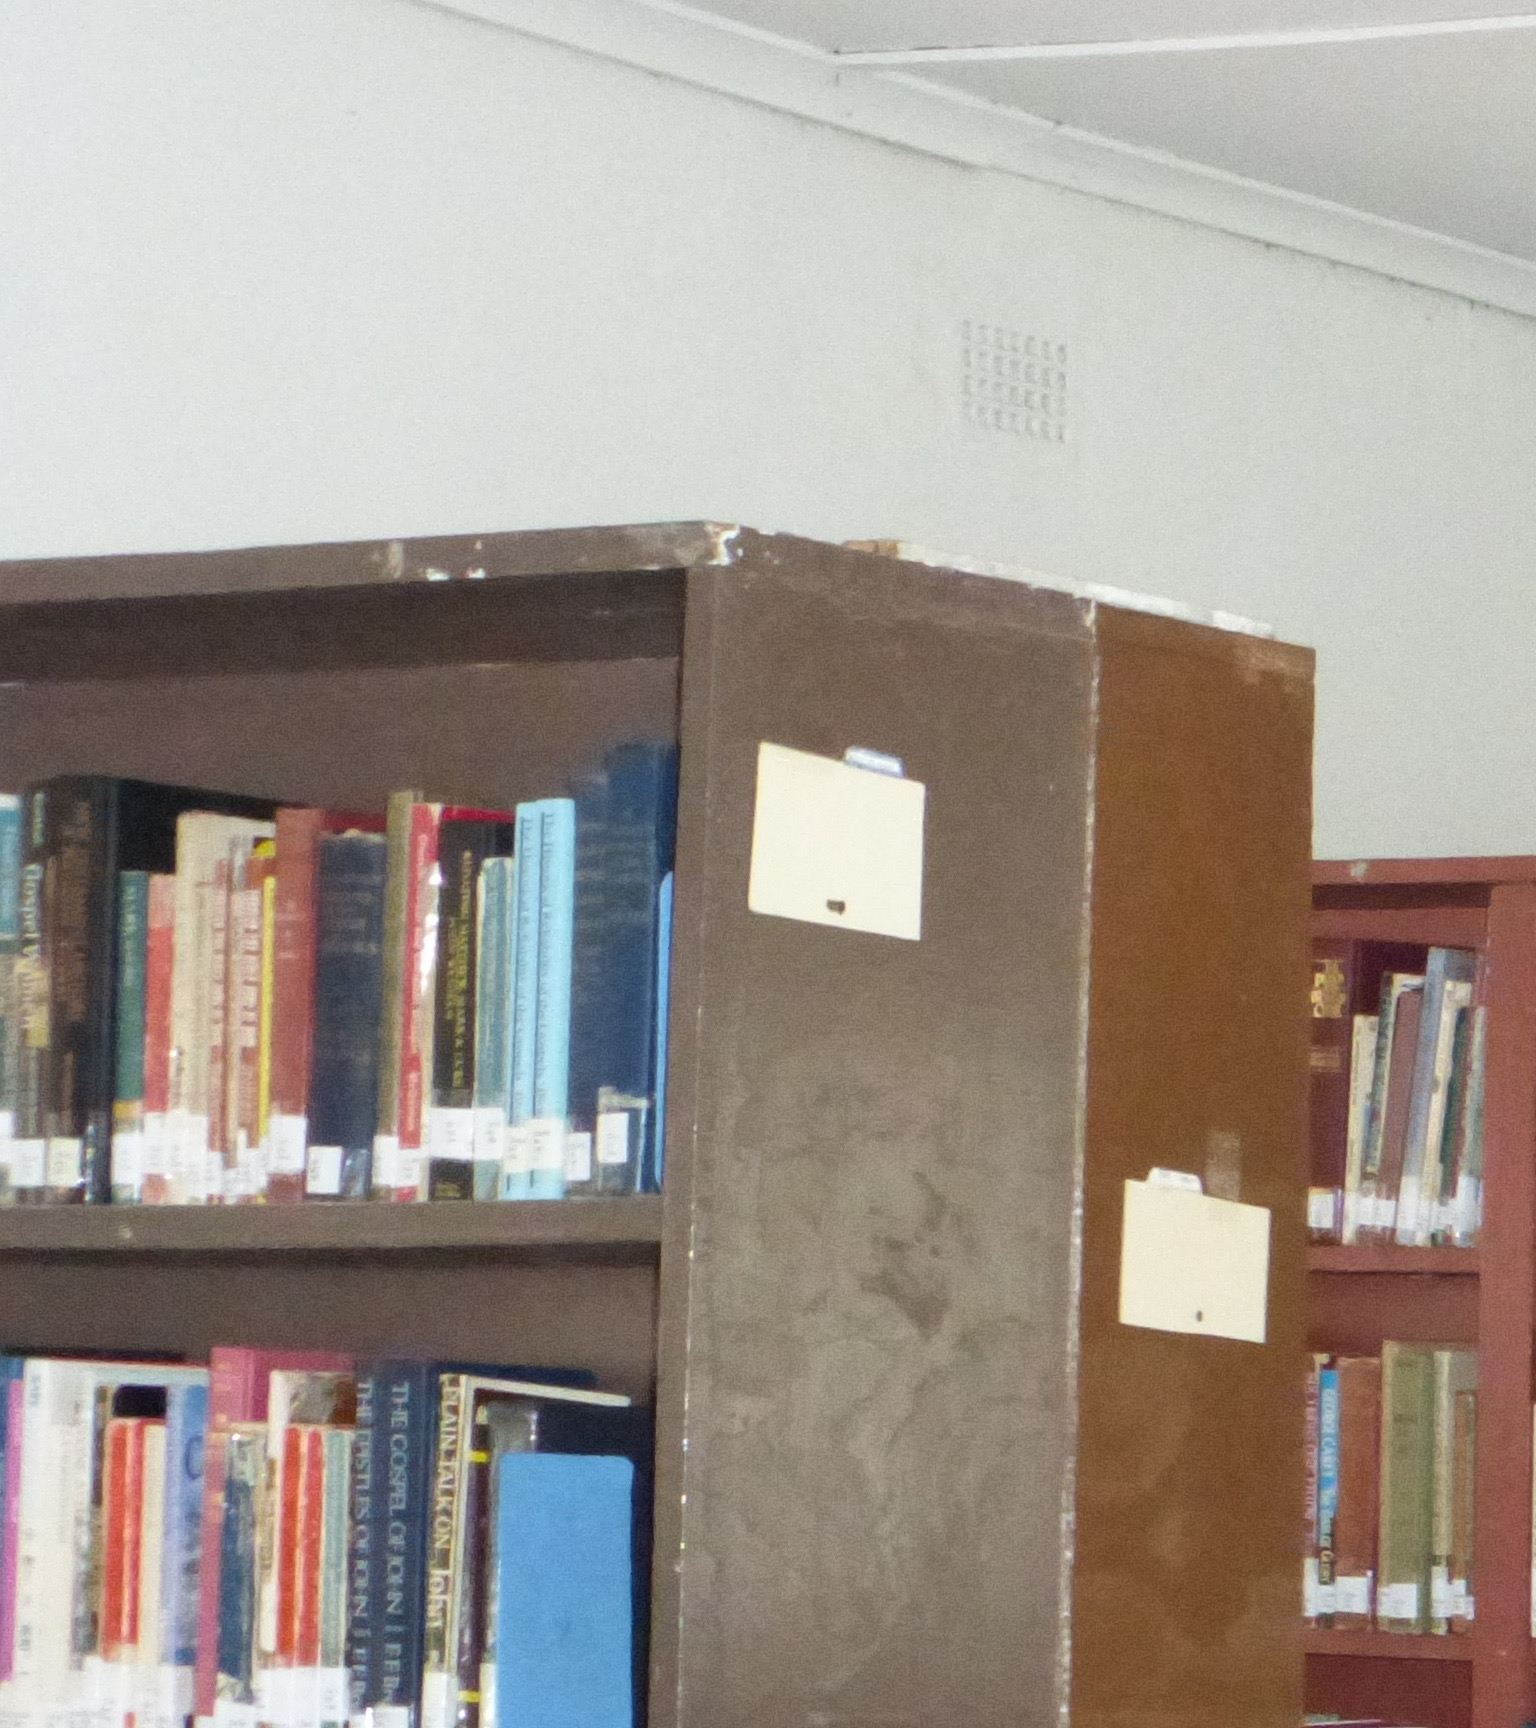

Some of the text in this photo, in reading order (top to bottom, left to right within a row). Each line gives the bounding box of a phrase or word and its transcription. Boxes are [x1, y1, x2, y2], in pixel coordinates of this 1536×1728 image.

[390, 1381, 411, 1427] THE
[388, 1433, 409, 1513] GOSPEL
[434, 1459, 455, 1511] TALK
[387, 1520, 406, 1549] OF
[433, 1515, 452, 1550] ON
